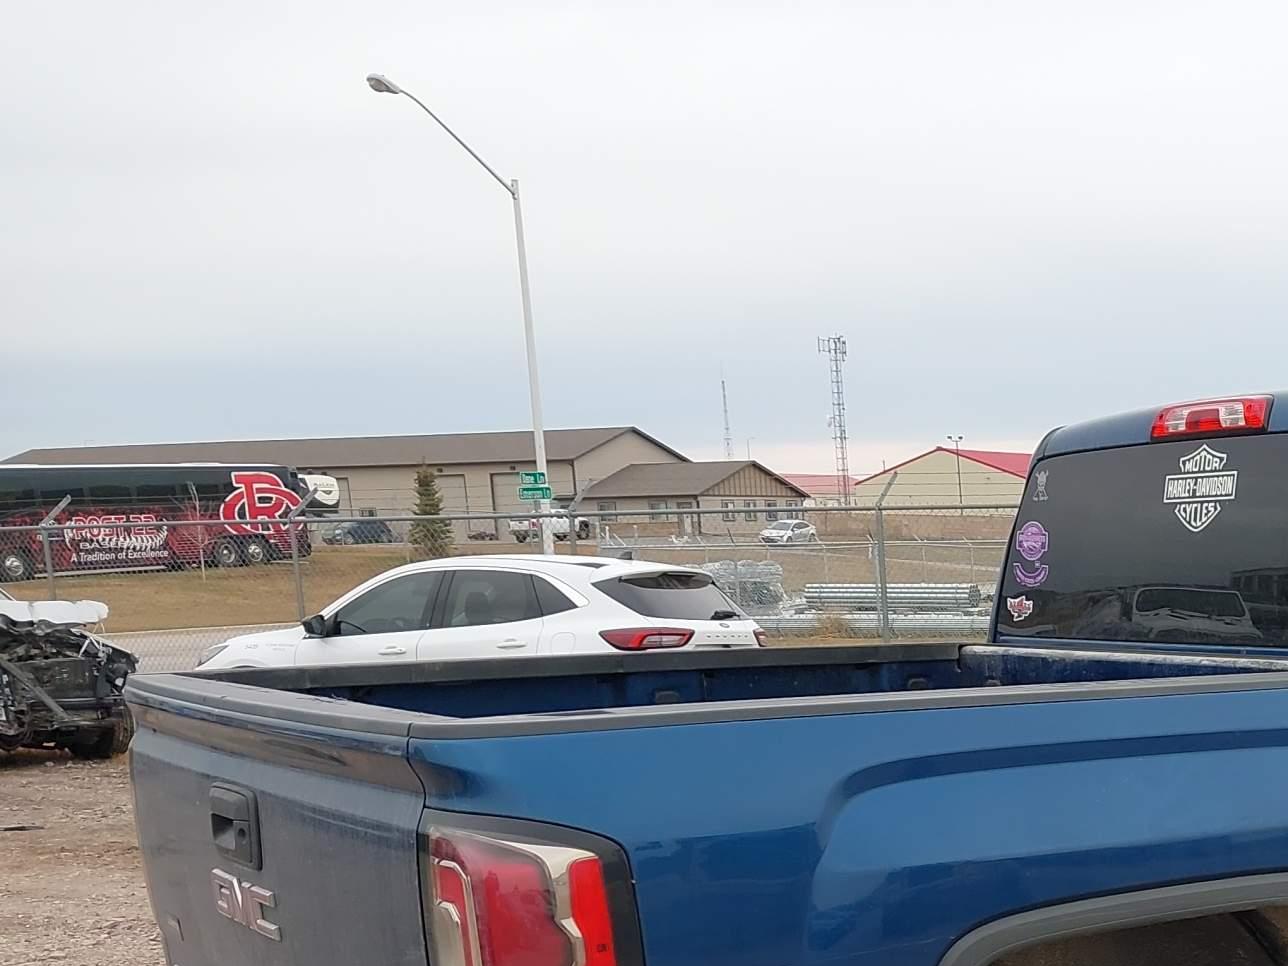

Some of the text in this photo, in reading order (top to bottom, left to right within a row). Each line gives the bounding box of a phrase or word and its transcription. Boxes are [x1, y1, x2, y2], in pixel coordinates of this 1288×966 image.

[1184, 450, 1220, 472] MOTOR
[1167, 476, 1234, 498] HARLEY-DAVIDSON
[1180, 502, 1216, 527] CYCLES
[72, 514, 157, 540] POST 22
[70, 549, 169, 563] A Tradition of Excellence
[211, 868, 282, 941] GMC
